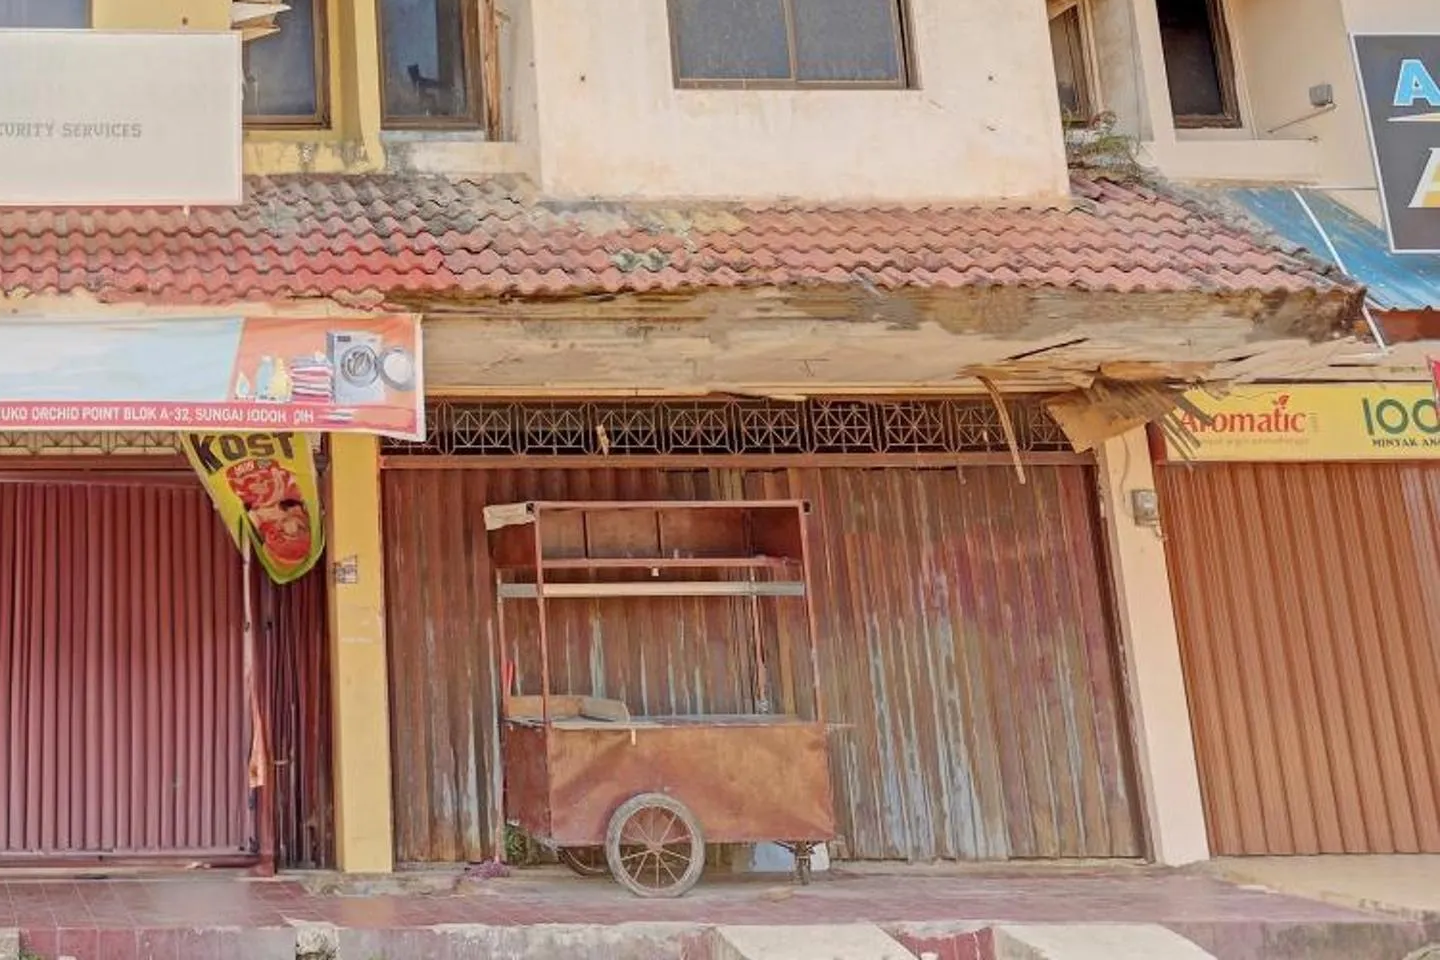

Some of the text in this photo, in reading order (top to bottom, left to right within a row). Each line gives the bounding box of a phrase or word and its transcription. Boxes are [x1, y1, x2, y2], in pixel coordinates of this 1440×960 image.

[61, 122, 142, 138] SERVICES
[32, 406, 80, 421] ORCHID
[82, 406, 119, 421] POINT
[123, 406, 157, 421] BLOK
[195, 407, 244, 422] SUNGAI
[189, 431, 294, 475] KOST
